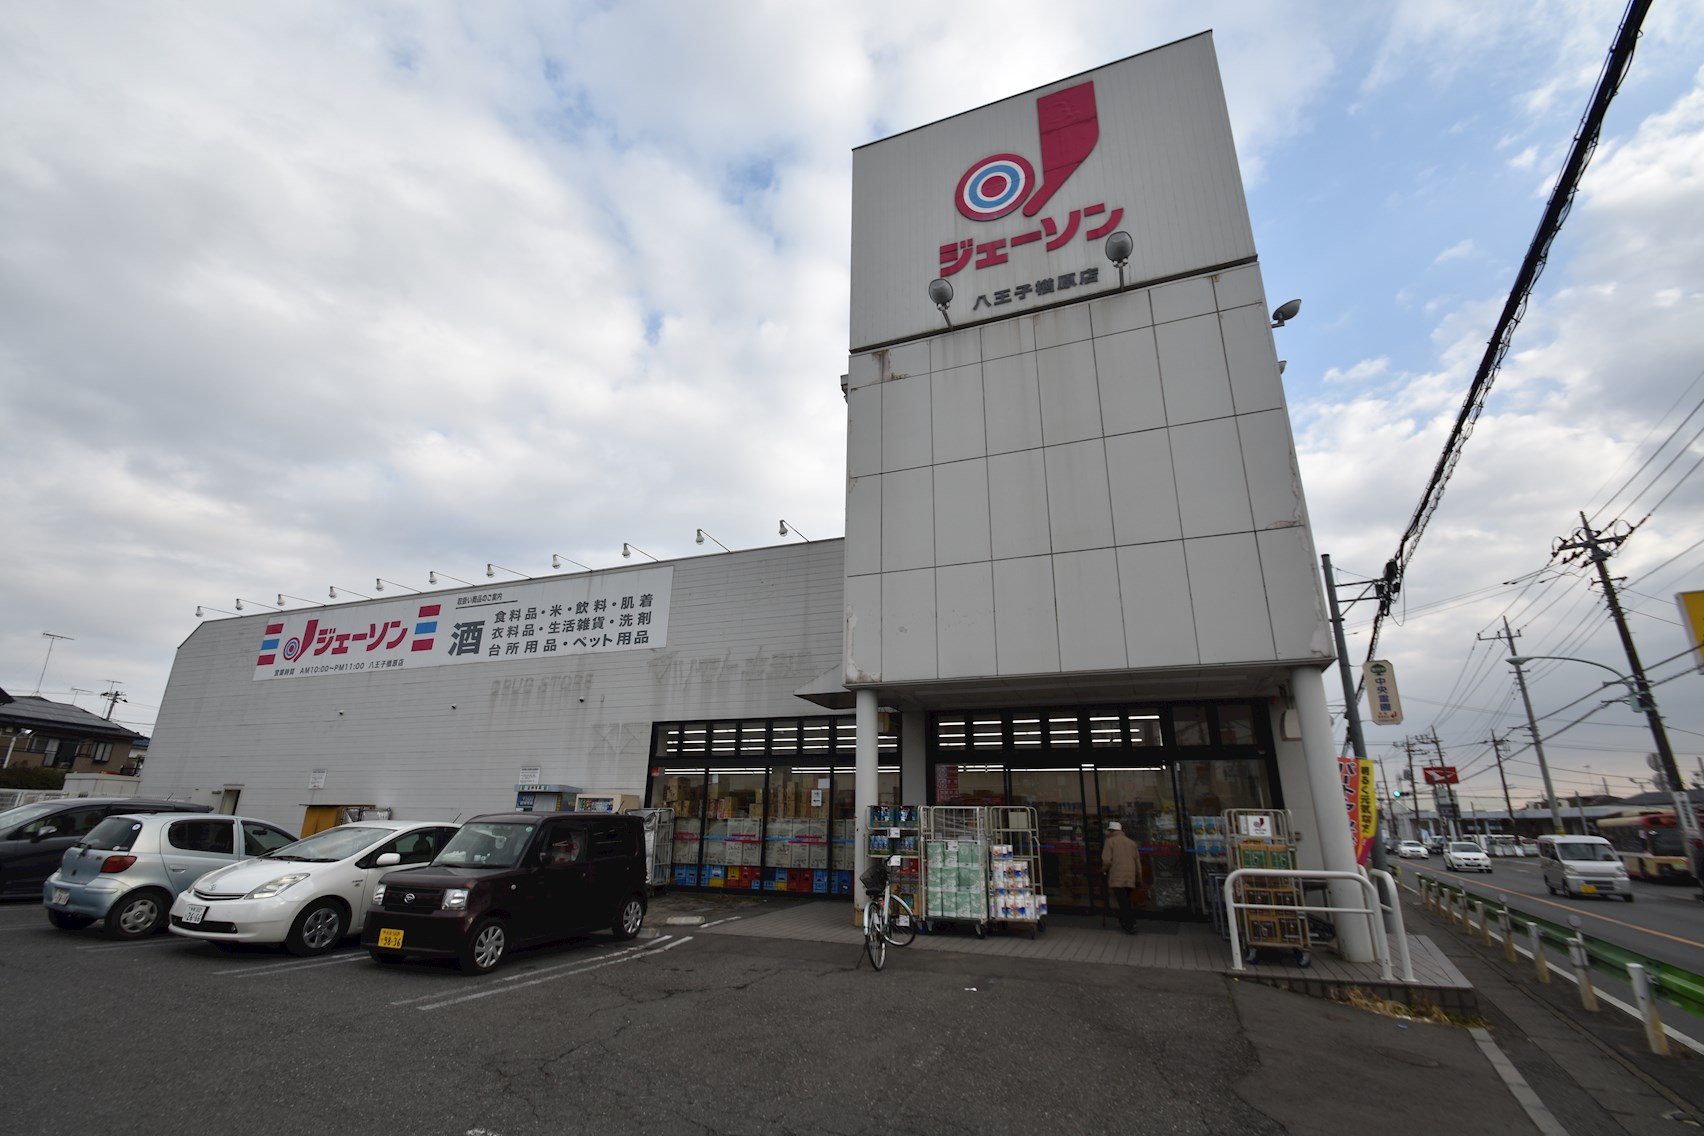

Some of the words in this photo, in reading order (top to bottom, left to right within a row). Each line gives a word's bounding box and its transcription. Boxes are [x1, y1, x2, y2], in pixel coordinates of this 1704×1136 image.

[940, 203, 1124, 278] ジェーソン
[313, 620, 408, 656] ジェーソン
[448, 620, 486, 656] 酒
[488, 630, 649, 657] 台所用品・ペット用品
